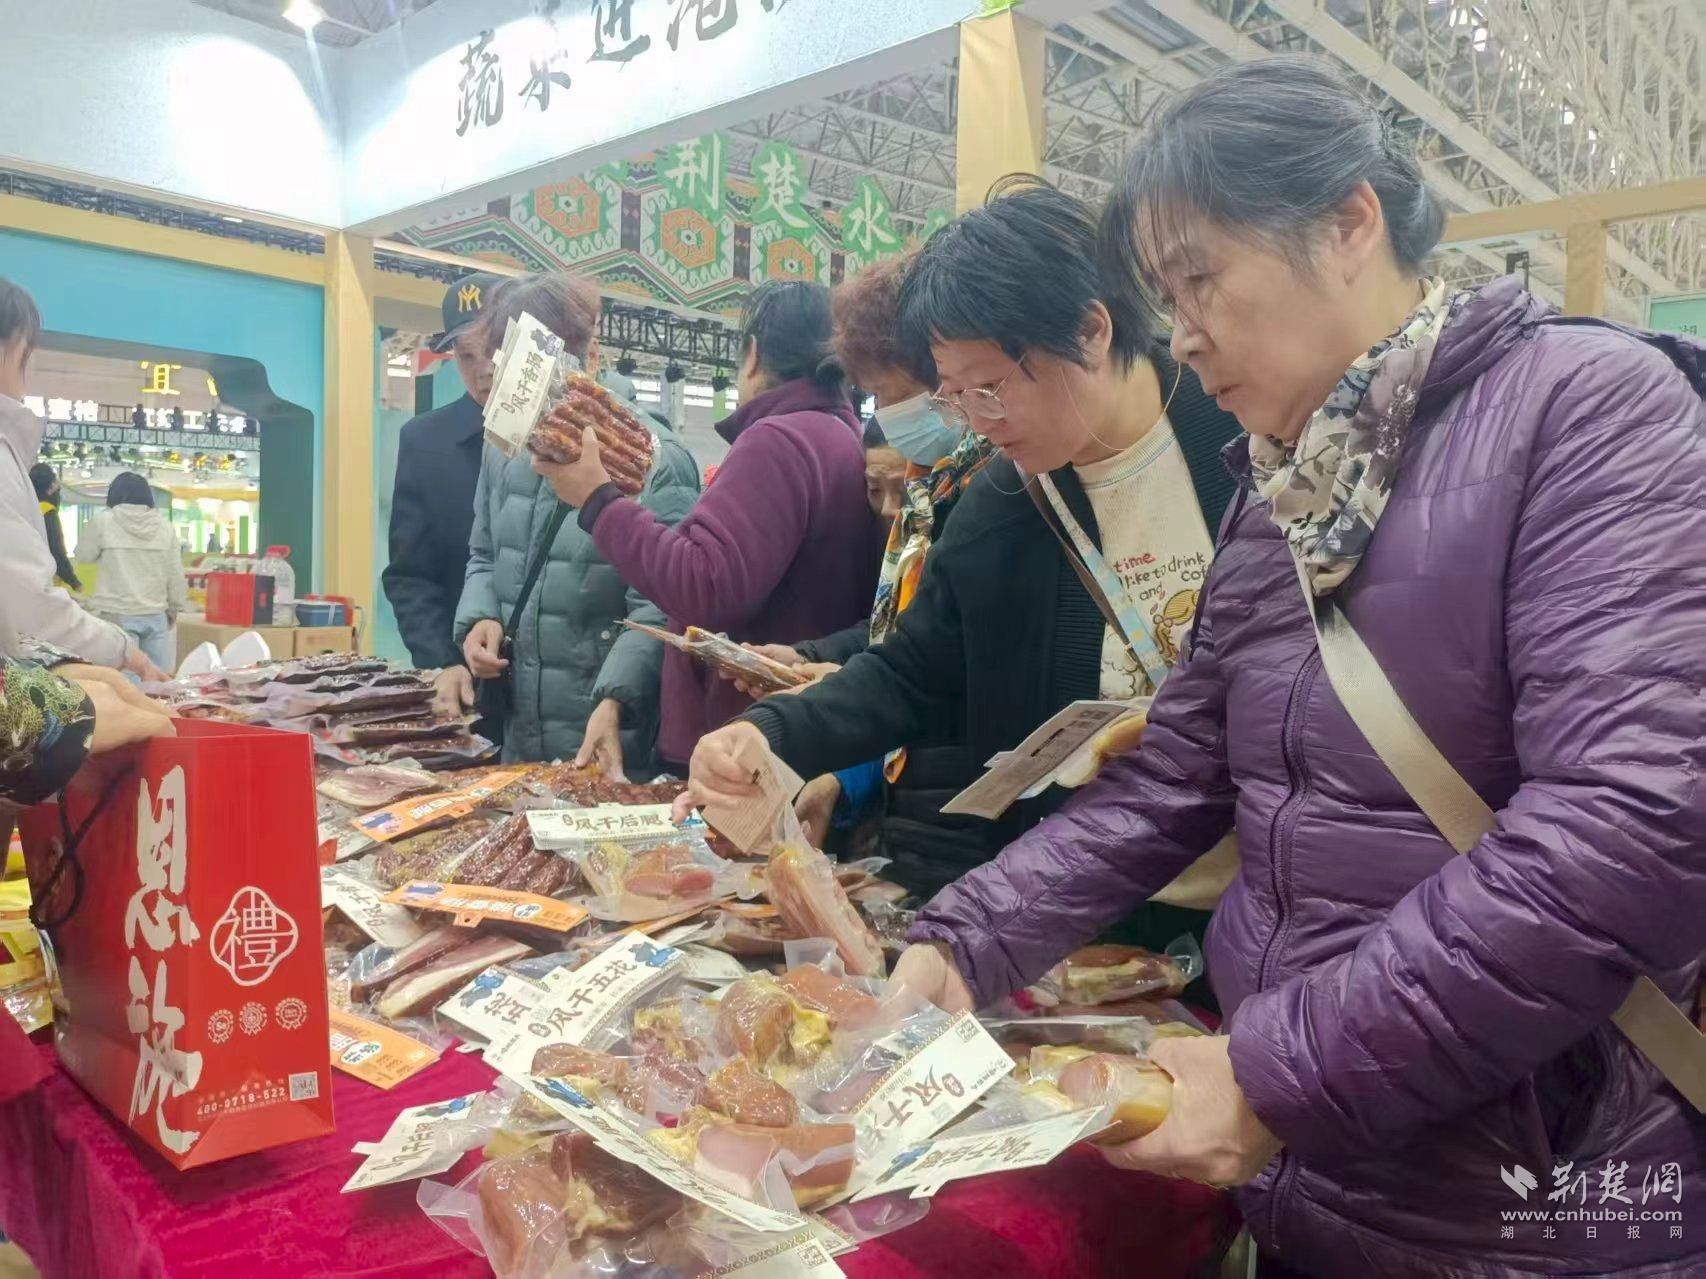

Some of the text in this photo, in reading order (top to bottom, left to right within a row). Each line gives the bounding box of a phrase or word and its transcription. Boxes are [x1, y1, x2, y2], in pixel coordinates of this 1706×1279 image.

[665, 133, 947, 251] 荆楚水
[1113, 552, 1156, 573] time
[1125, 571, 1150, 588] like
[1168, 552, 1206, 573] drink
[1139, 582, 1163, 601] and
[575, 814, 664, 831] 风干后腿
[219, 888, 294, 971] 禮
[546, 959, 638, 1037] 风干五花
